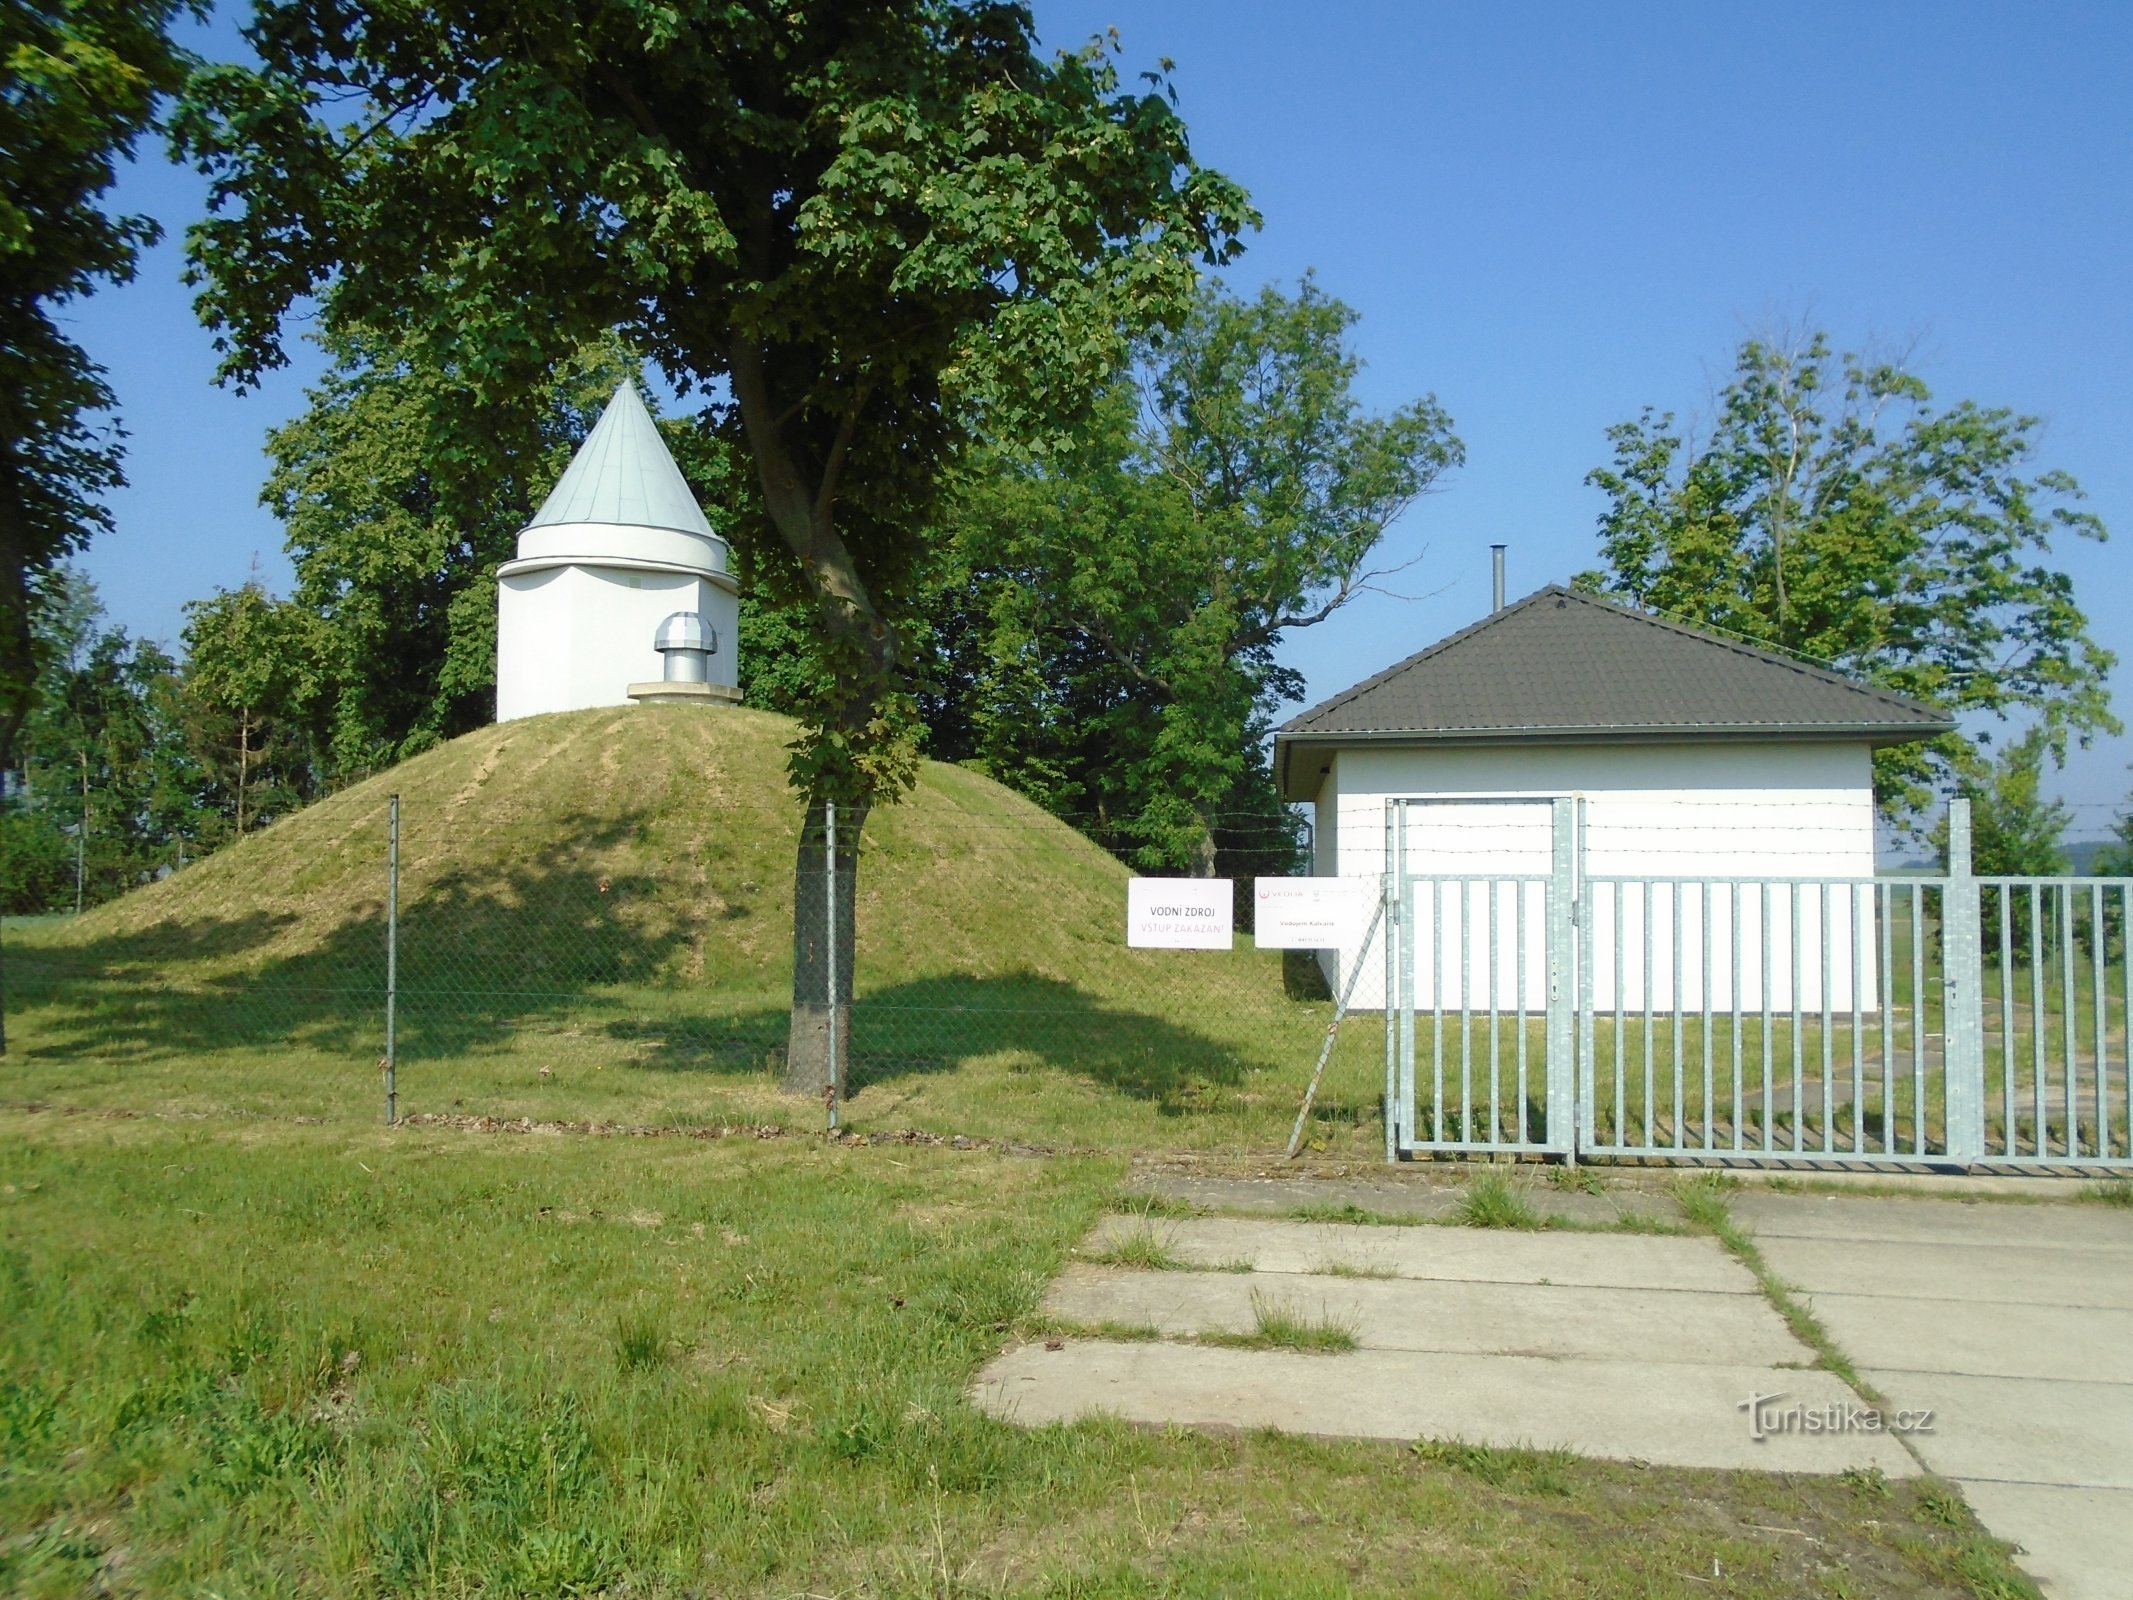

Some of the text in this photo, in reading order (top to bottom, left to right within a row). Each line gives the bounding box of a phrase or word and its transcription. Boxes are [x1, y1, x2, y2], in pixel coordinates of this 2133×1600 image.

[1150, 904, 1215, 917] VODNÍ ZDROJ
[1141, 923, 1172, 933] VSTUP
